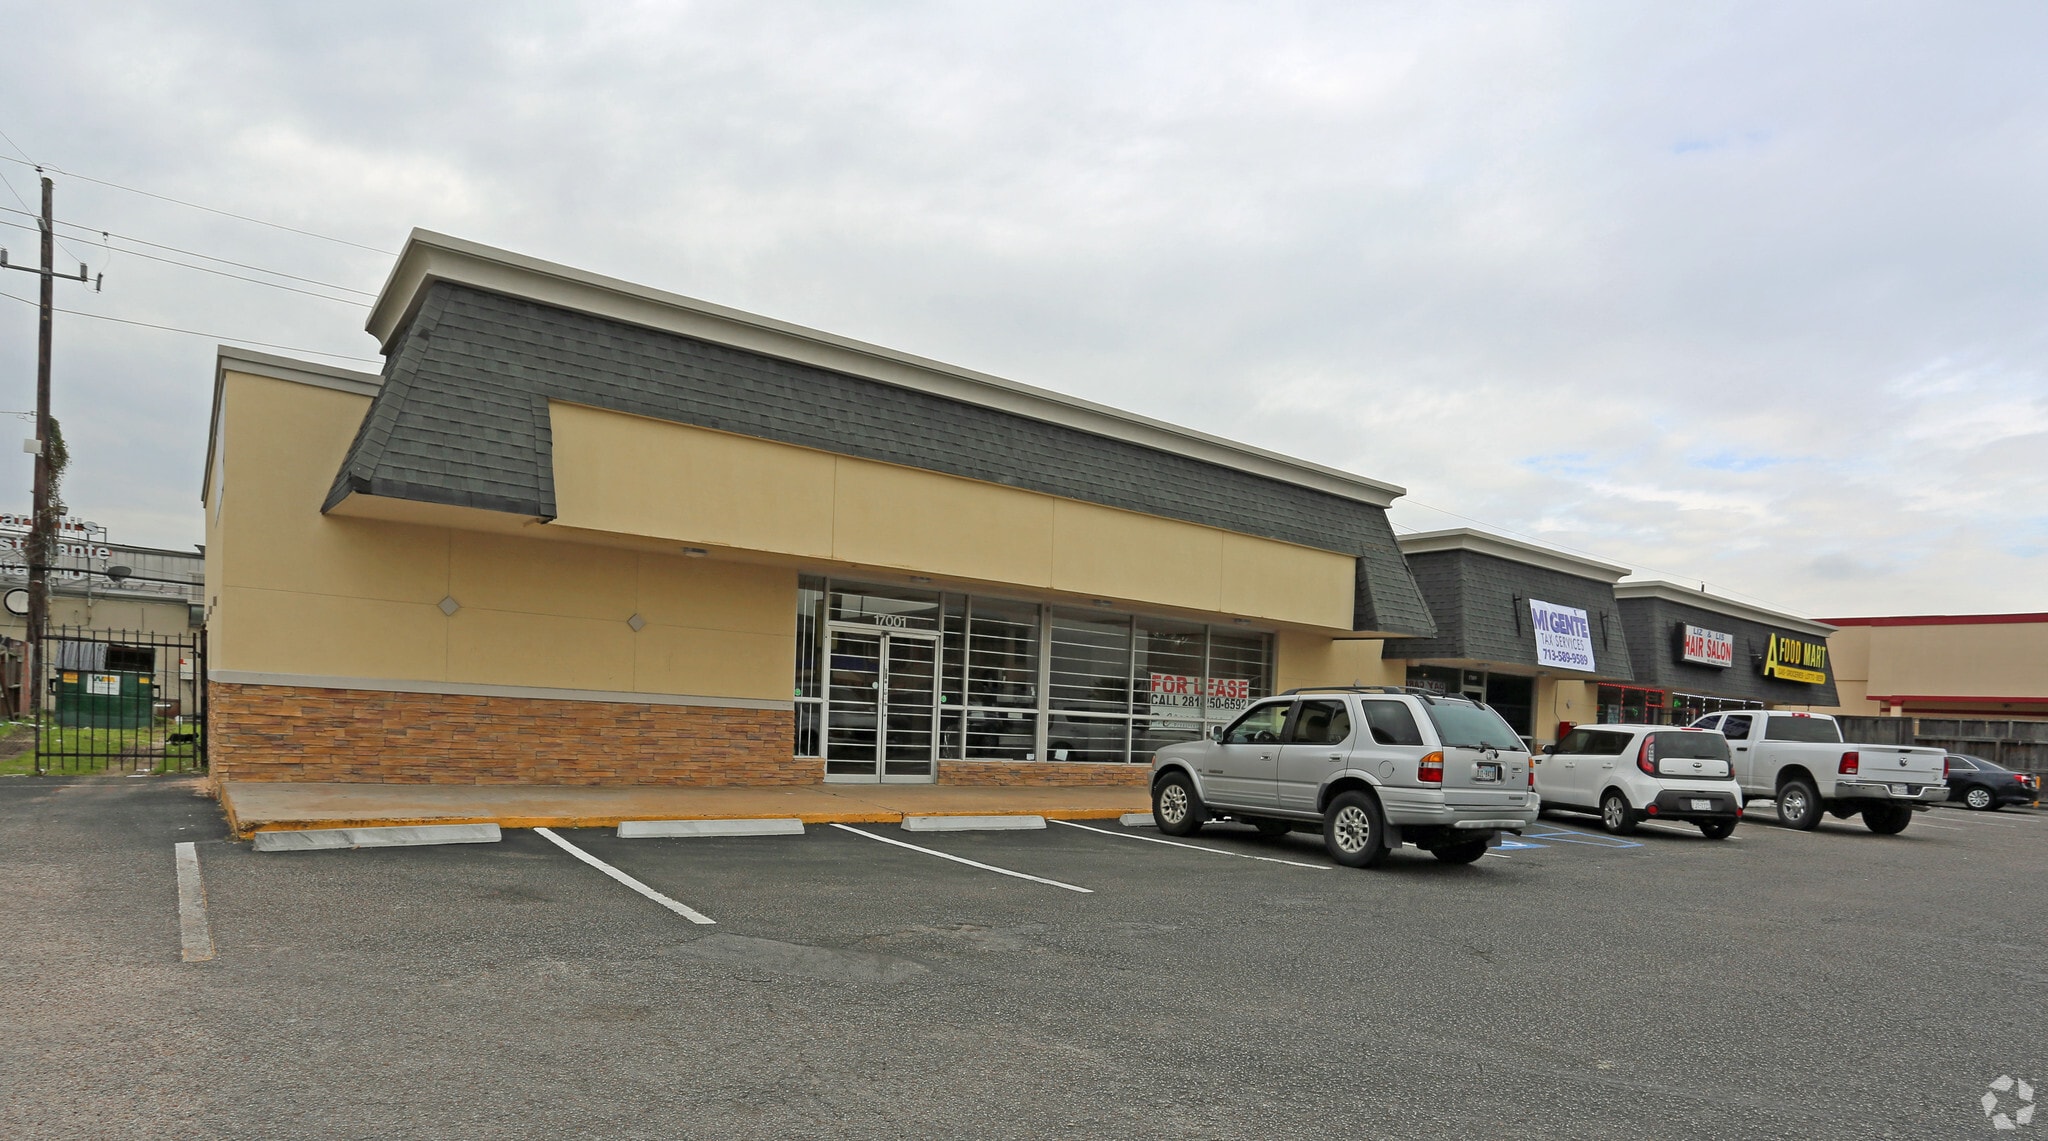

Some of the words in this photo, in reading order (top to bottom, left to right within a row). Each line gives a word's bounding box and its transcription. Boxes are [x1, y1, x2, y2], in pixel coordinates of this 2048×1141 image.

[874, 613, 907, 628] 17001
[1532, 608, 1549, 631] MI
[1550, 611, 1588, 638] GENTE
[1540, 633, 1553, 646] TAX
[1555, 635, 1584, 651] SERVICES
[1693, 628, 1703, 636] LIZ
[1716, 633, 1724, 641] LIS
[1543, 648, 1588, 666] 713-589-9589
[1684, 634, 1704, 658] HAIR
[1707, 639, 1732, 662] SALON
[1764, 632, 1778, 677] A
[1779, 637, 1801, 664] FOOD
[1803, 642, 1826, 669] MART
[1151, 674, 1187, 694] FOR
[1194, 678, 1249, 699] LEASE
[1151, 694, 1179, 706] CALL
